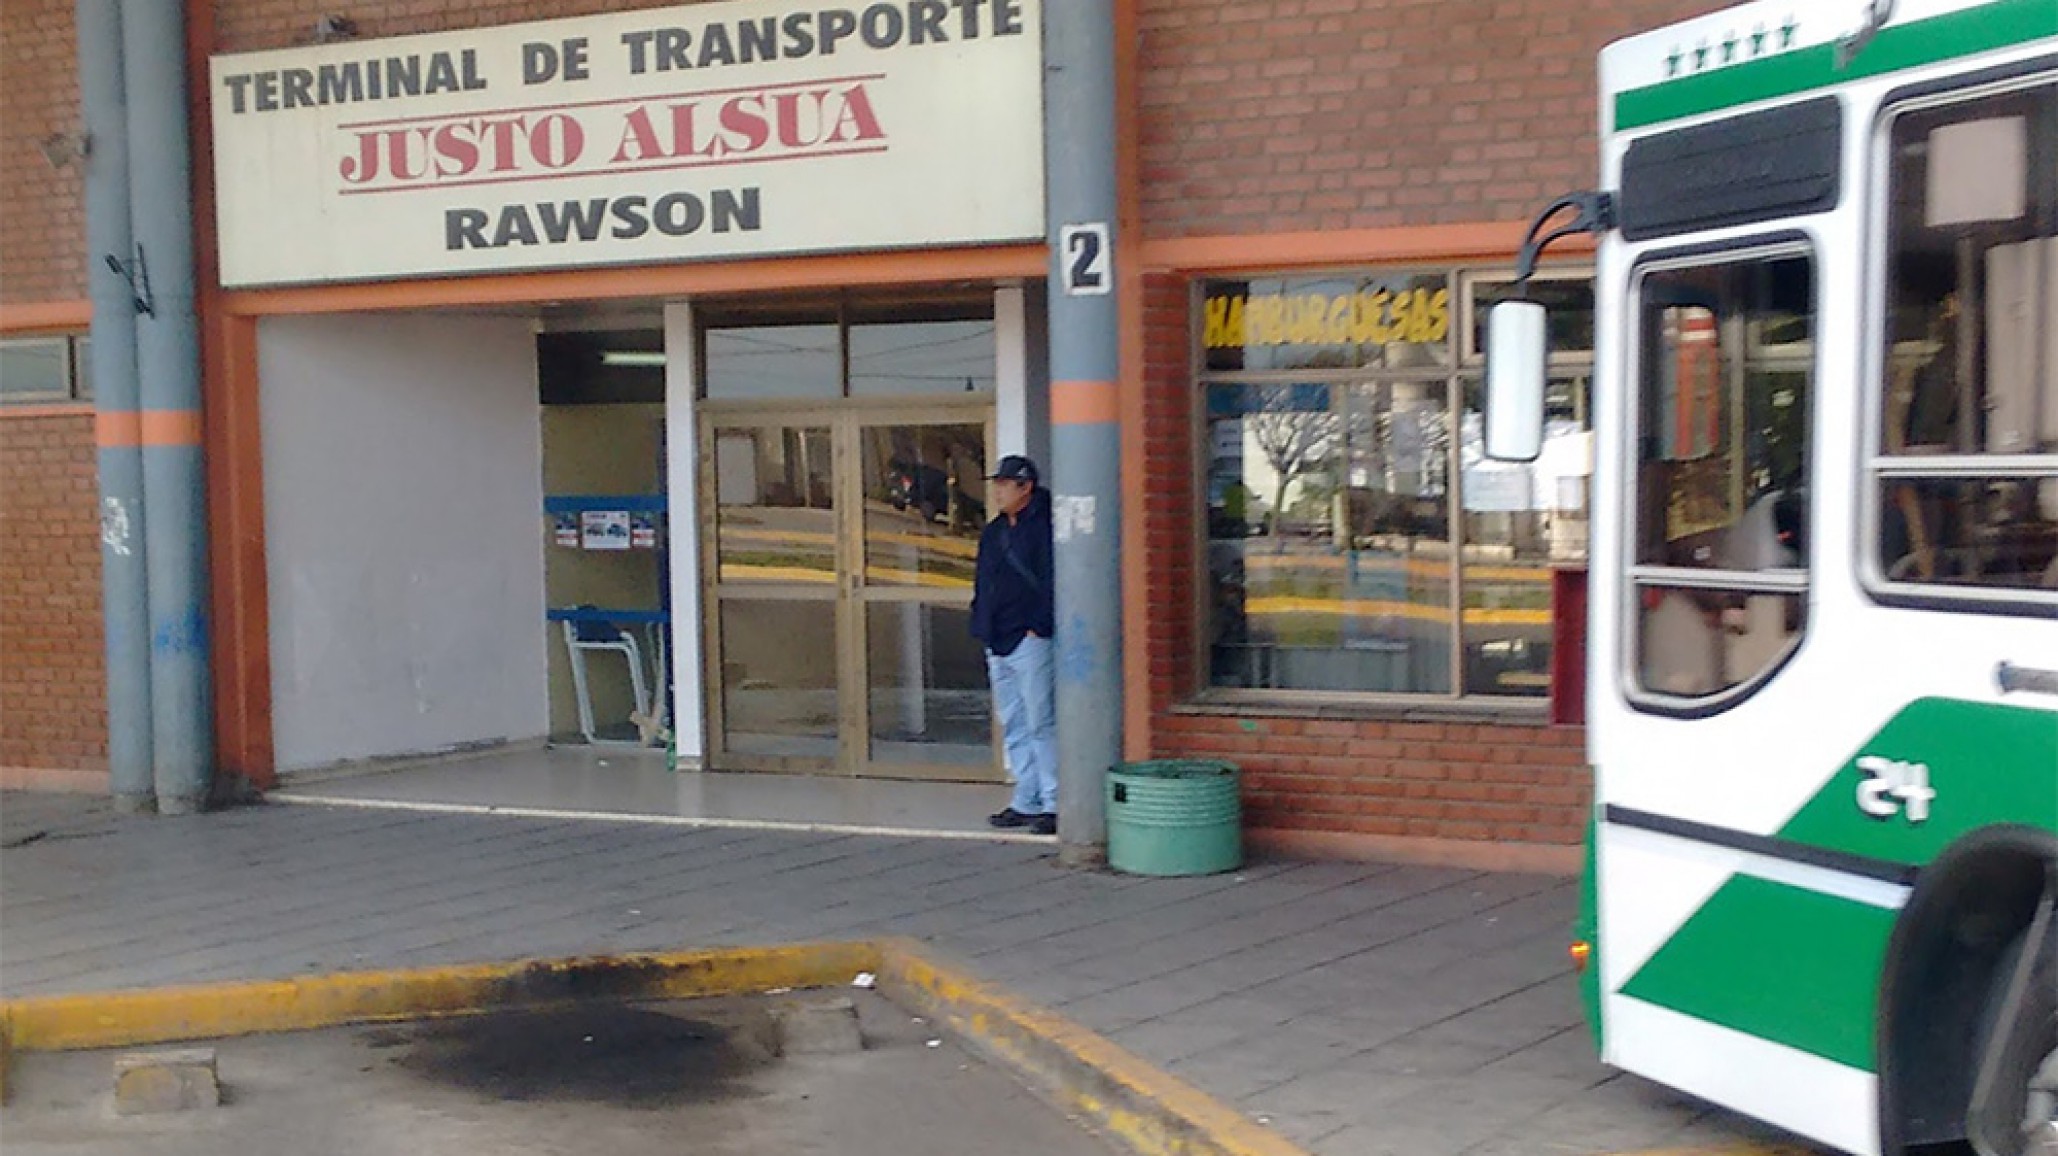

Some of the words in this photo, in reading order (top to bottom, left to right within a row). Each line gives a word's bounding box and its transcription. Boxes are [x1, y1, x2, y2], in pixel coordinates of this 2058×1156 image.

[224, 49, 487, 114] TERMINAL
[522, 37, 590, 86] DE
[621, 0, 1023, 75] TRANSPORTE
[339, 113, 585, 184] JUSTO
[608, 82, 887, 162] ALSUA
[445, 187, 761, 250] RAWSON
[1069, 230, 1102, 288] 2
[1856, 756, 1937, 821] 24
